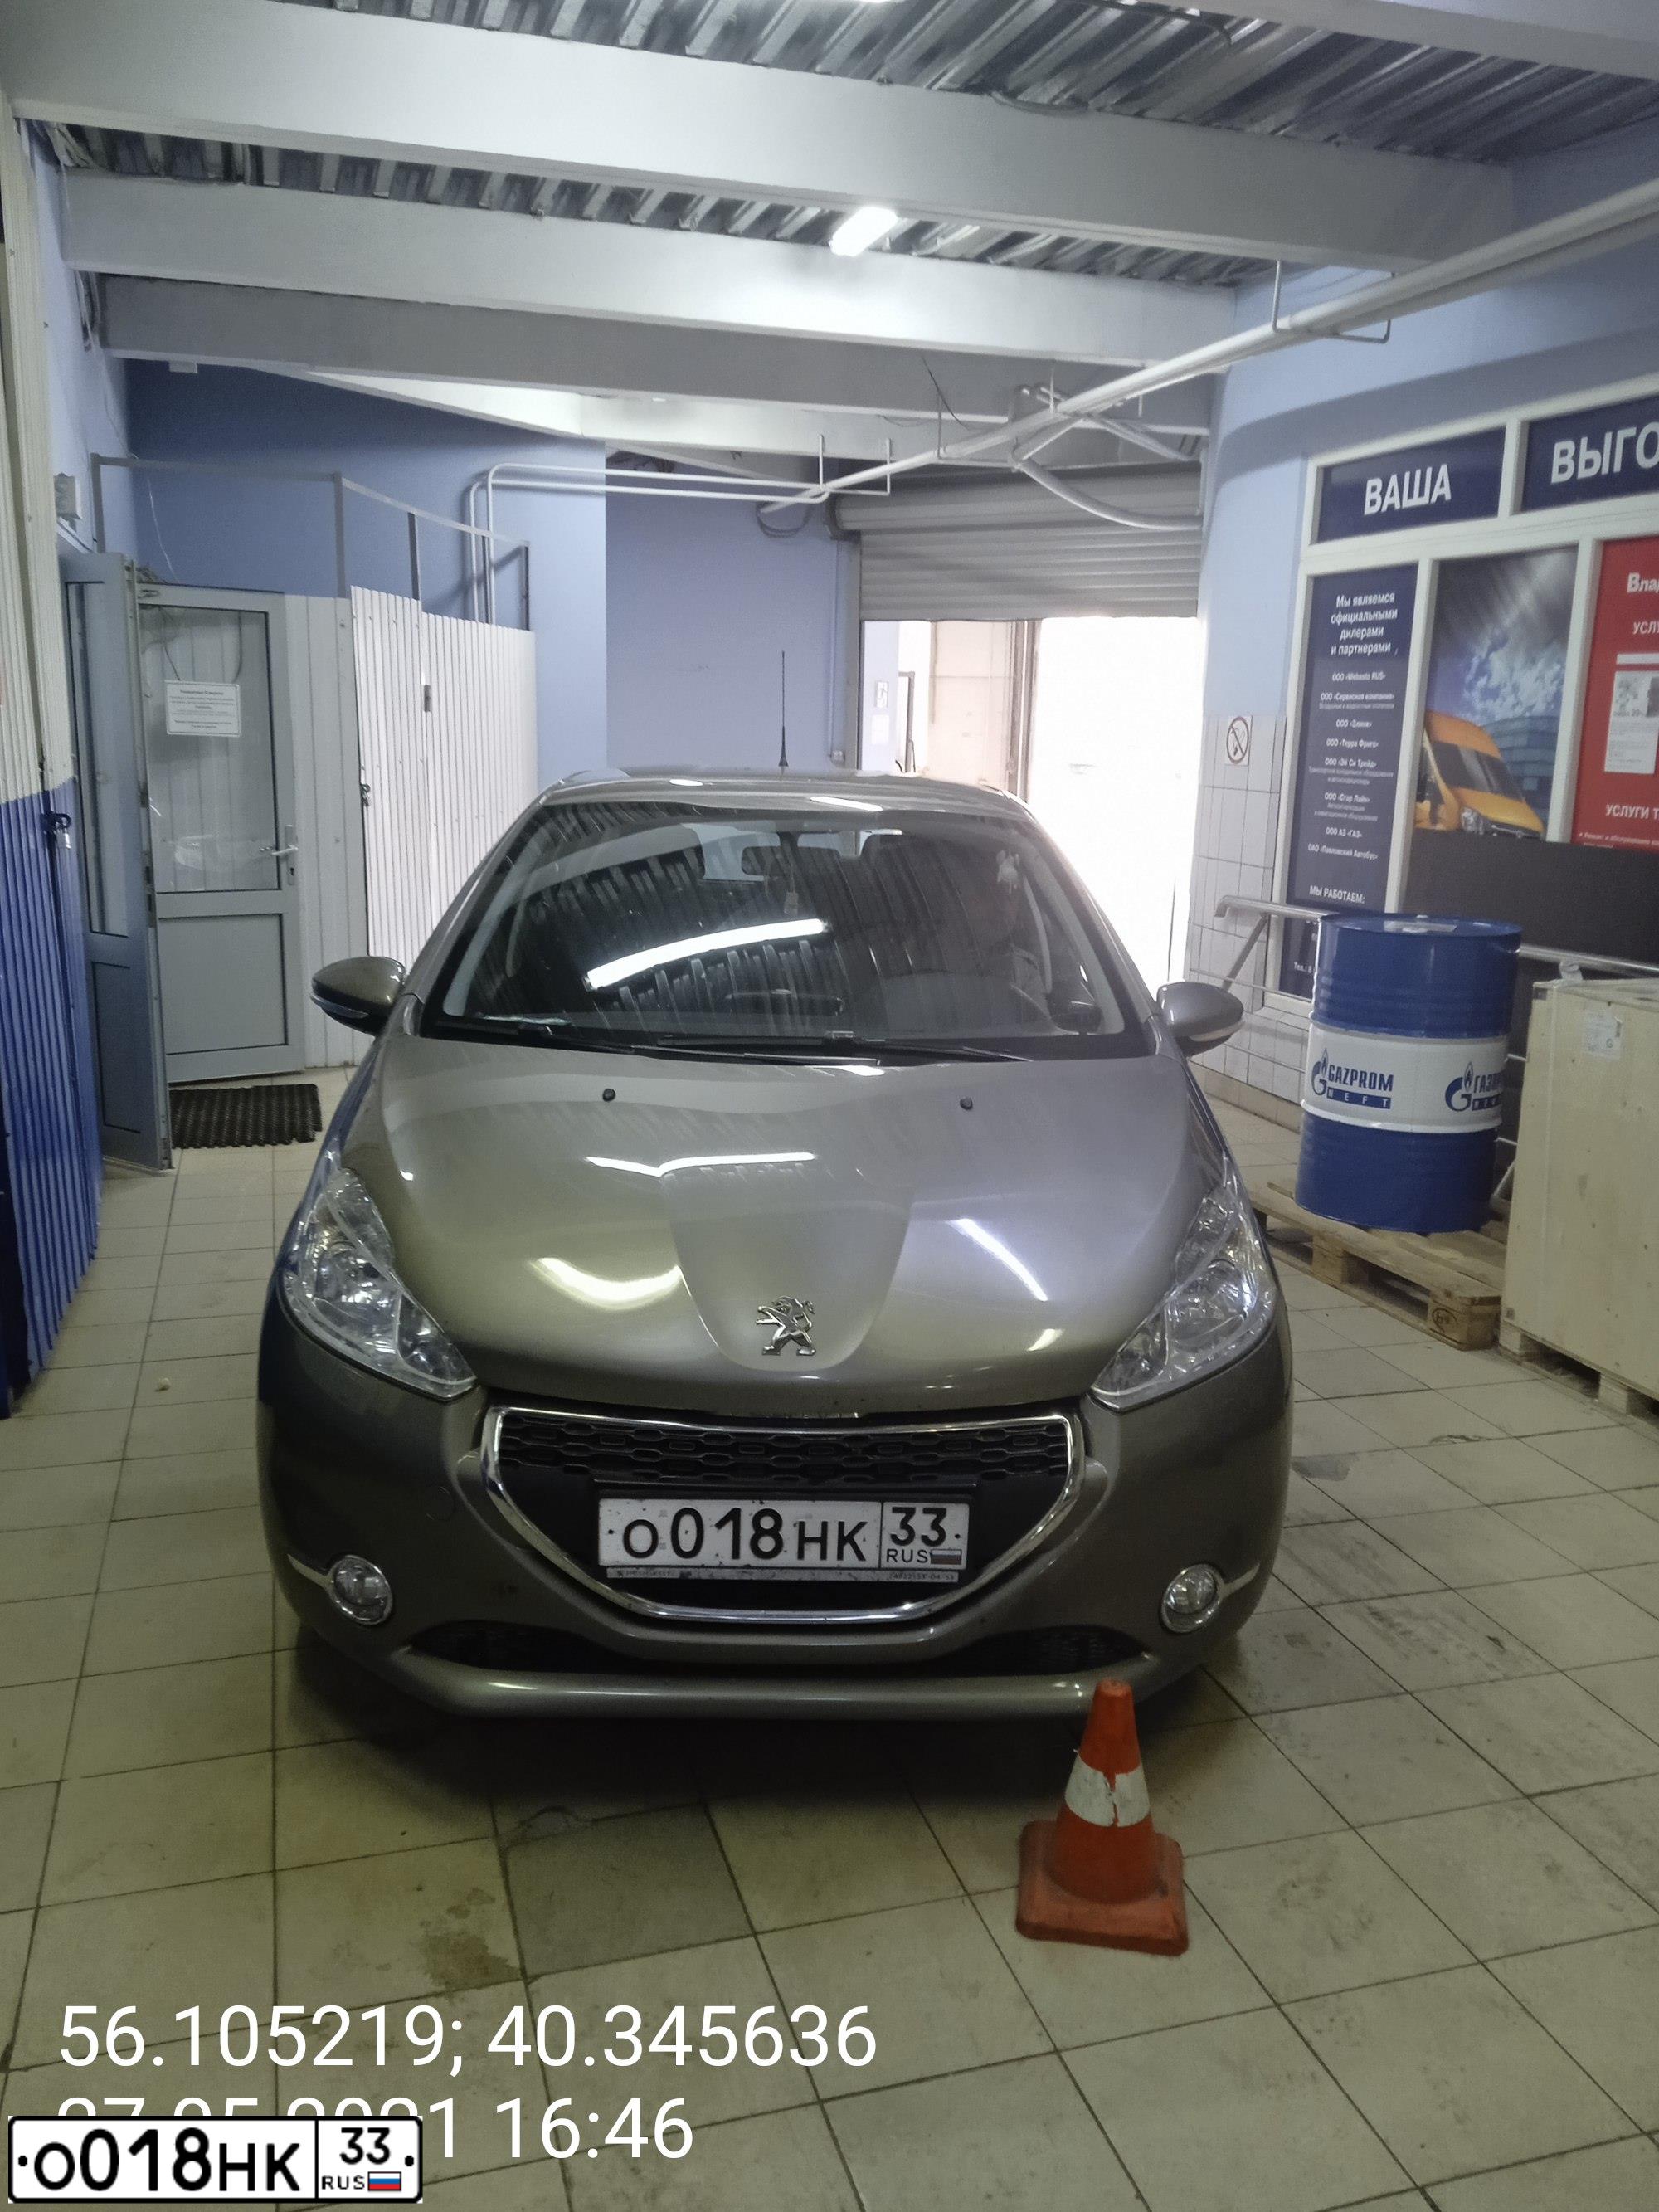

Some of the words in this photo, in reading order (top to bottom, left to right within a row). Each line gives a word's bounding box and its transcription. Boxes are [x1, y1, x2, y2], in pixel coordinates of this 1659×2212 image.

[1364, 464, 1452, 515] ВАША
[1336, 595, 1350, 608] Мы
[1353, 592, 1395, 607] являемся
[1331, 609, 1398, 626] официальными
[1340, 627, 1384, 641] дилерами
[1331, 646, 1336, 655] и
[1338, 642, 1390, 657] партнерами
[1321, 692, 1333, 701] ООО
[1335, 719, 1348, 728] ООО
[1325, 758, 1337, 766] ООО
[1325, 792, 1337, 801] ООО
[1606, 804, 1650, 820] УСЛУГИ
[1326, 826, 1338, 836] ООО
[1310, 885, 1322, 896] МЫ
[1324, 888, 1365, 904] РАБОТАЕМ:
[1328, 1065, 1394, 1091] GAZPROM
[891, 1507, 947, 1547] 33
[886, 1548, 928, 1563] RUS
